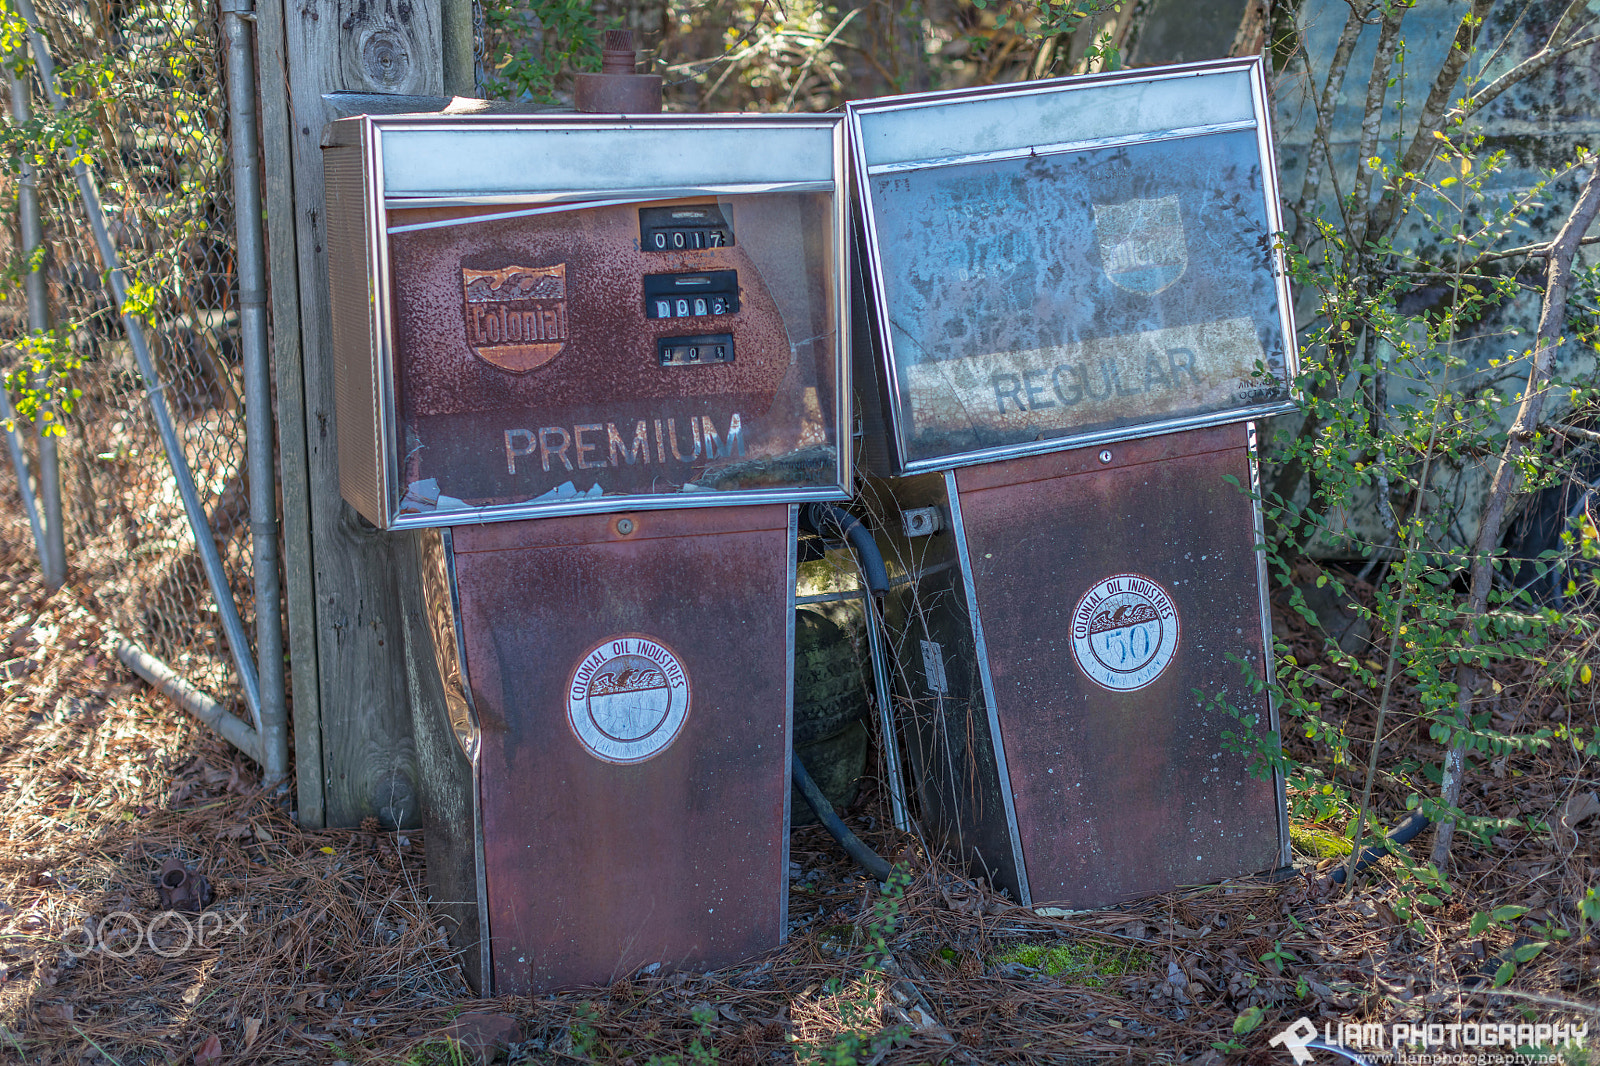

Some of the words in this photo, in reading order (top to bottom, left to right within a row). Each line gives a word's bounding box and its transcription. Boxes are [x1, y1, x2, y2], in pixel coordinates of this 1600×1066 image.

[473, 301, 565, 343] Colonial
[991, 347, 1199, 415] REGULAR
[504, 413, 746, 475] PREMIUM
[1075, 592, 1104, 640] COLONIAL
[1106, 580, 1123, 595] OIL
[1127, 579, 1174, 620] INDUSTRIES
[572, 651, 608, 701] COLONIAL
[612, 641, 631, 655] OIL
[637, 641, 685, 689] INDUSTRIES
[1106, 625, 1150, 664] 50
